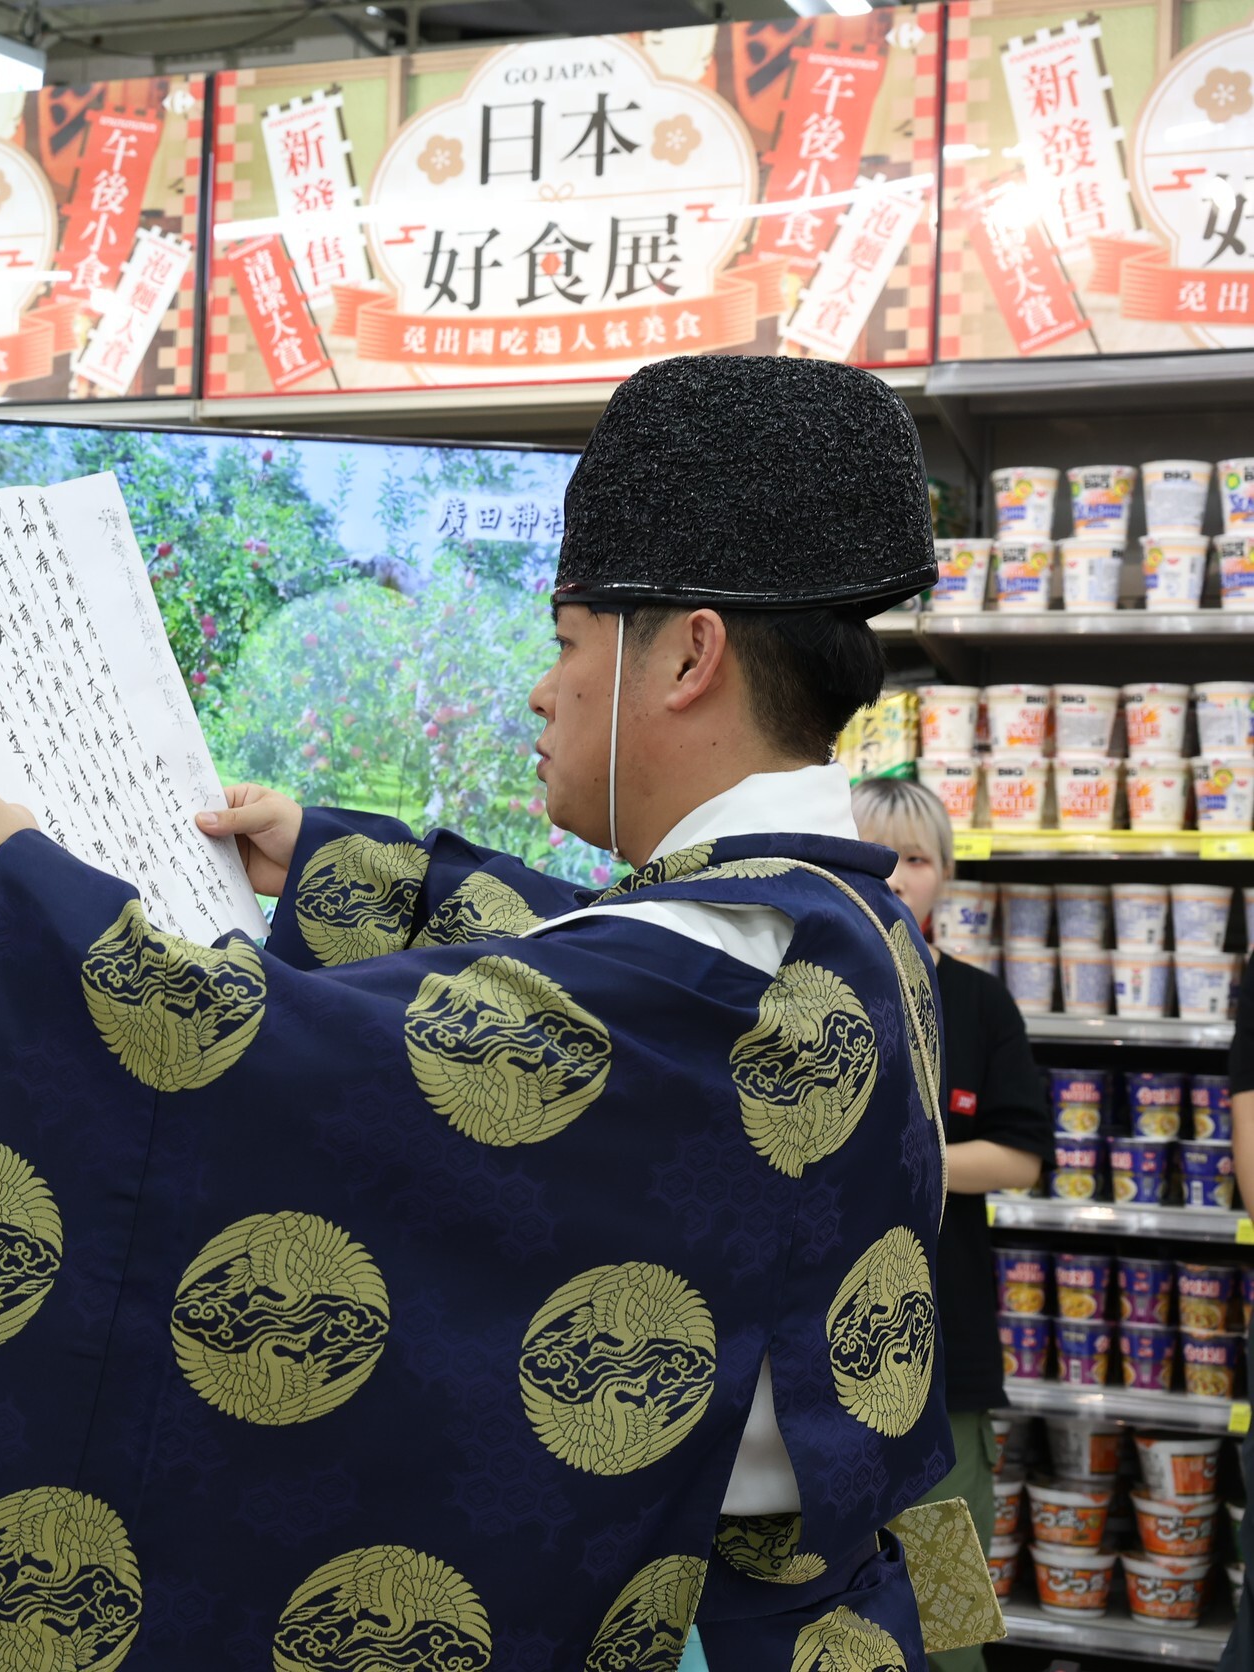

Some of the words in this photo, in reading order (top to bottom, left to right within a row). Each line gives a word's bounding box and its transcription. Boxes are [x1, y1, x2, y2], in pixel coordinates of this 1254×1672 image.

[505, 67, 538, 85] GO
[544, 60, 615, 82] JAPAN
[480, 92, 642, 185] 日本
[423, 213, 684, 312] 好食展
